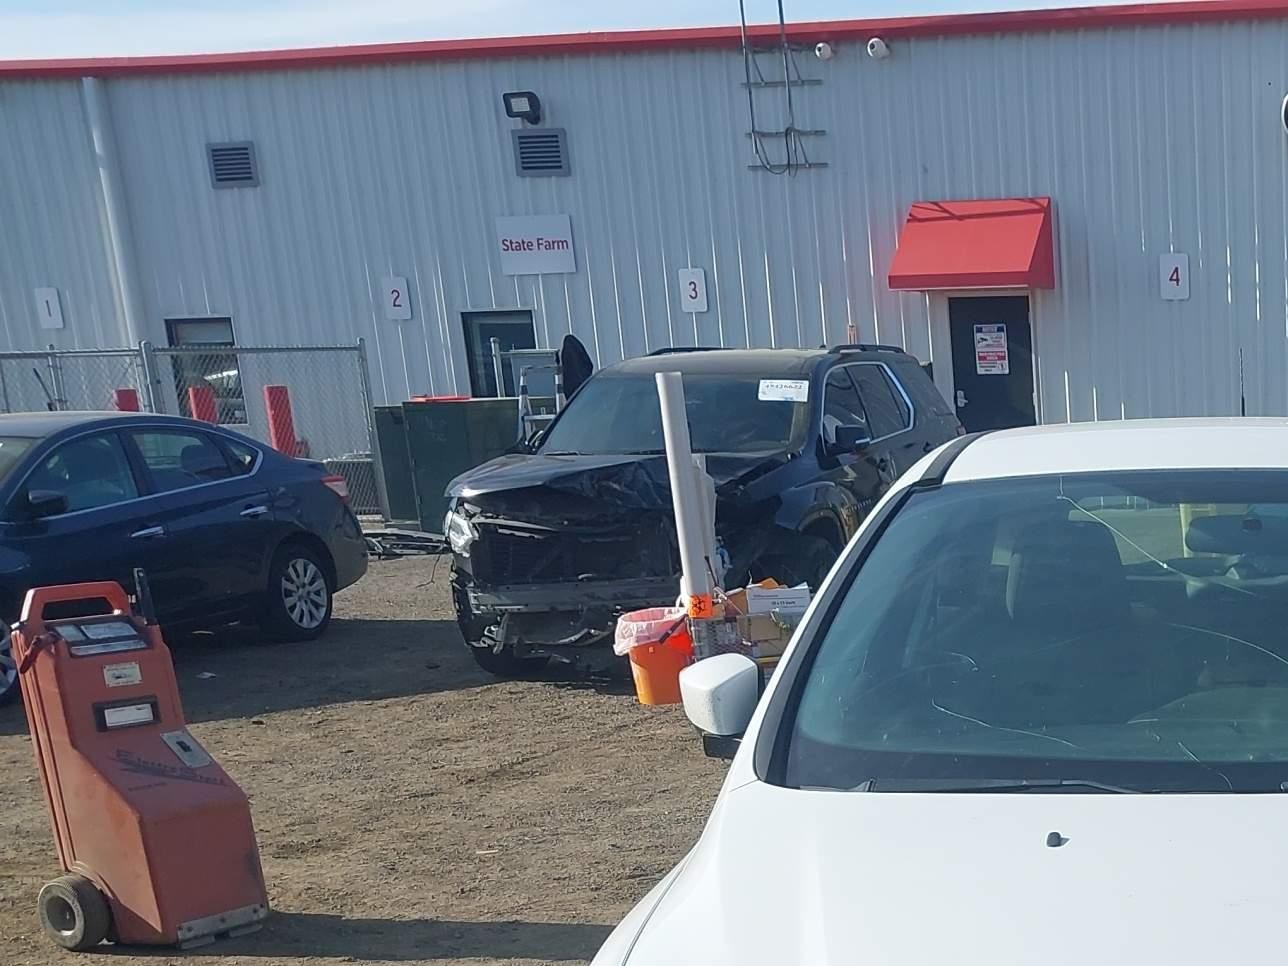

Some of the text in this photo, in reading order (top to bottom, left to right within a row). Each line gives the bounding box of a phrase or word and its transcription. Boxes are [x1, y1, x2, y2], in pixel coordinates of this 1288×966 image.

[501, 237, 569, 252] State Farm
[1169, 266, 1180, 287] 4
[391, 289, 403, 307] 2
[688, 280, 698, 300] 3
[45, 299, 52, 317] 1
